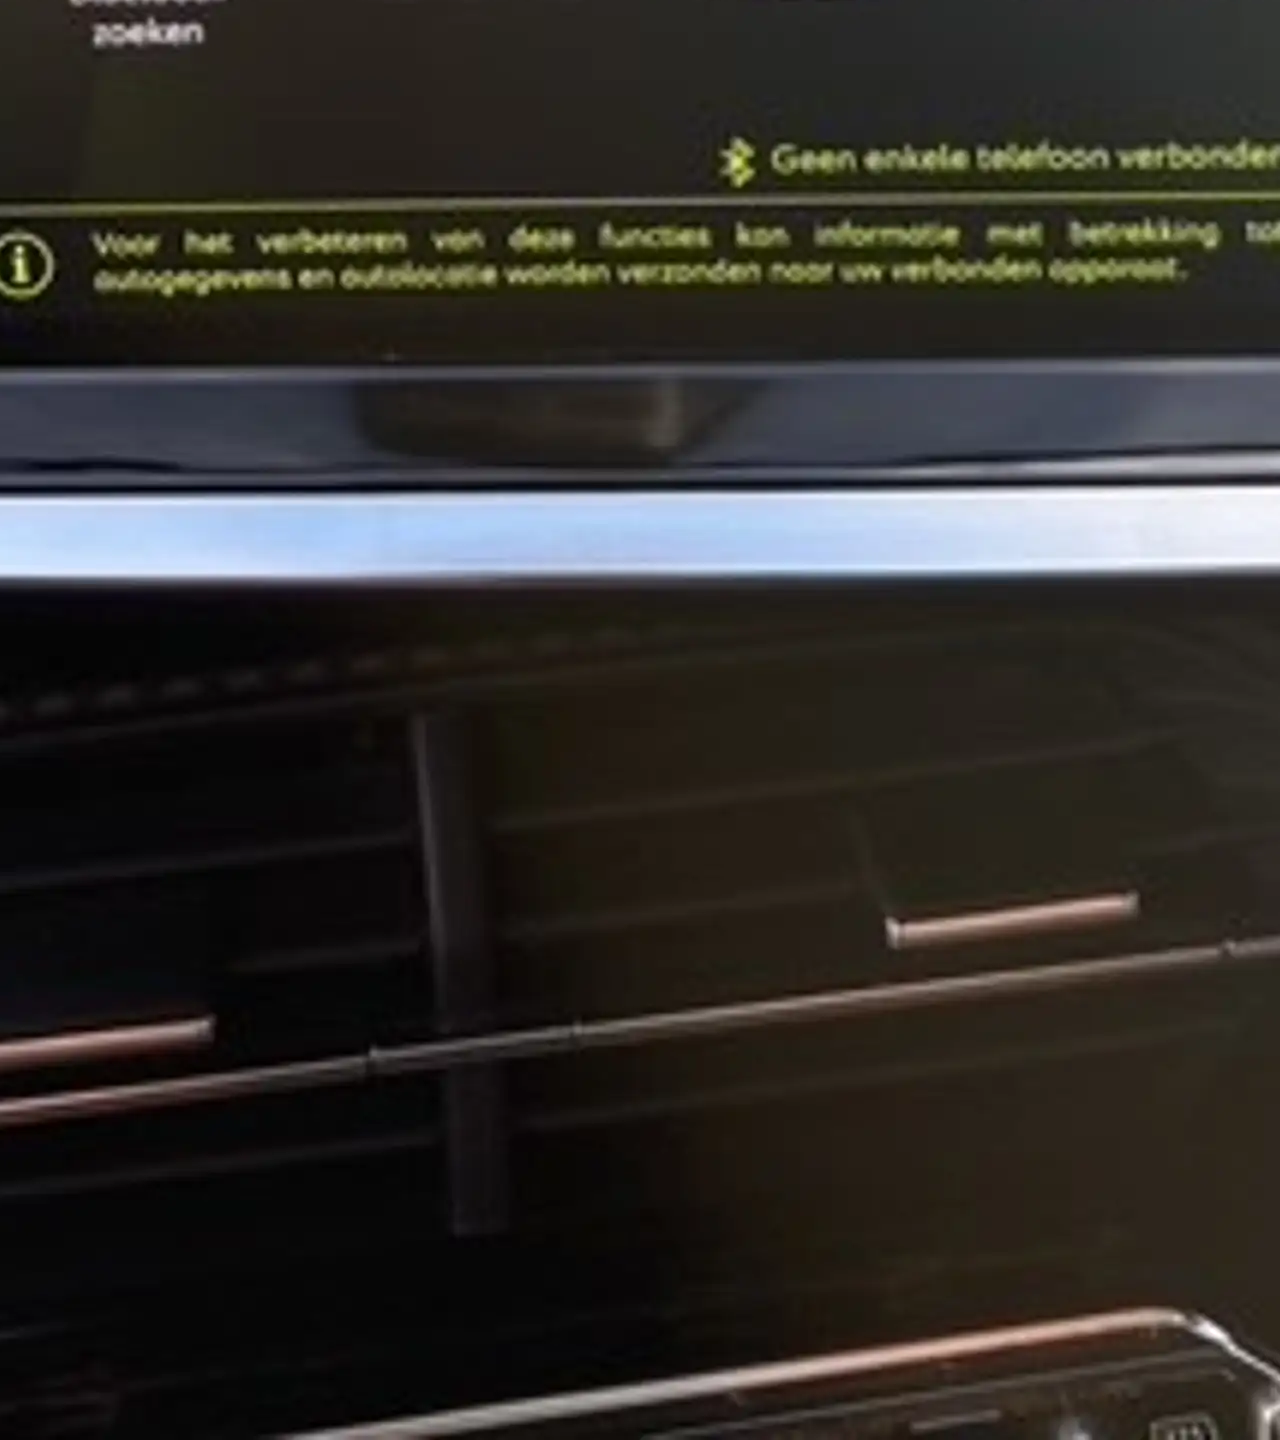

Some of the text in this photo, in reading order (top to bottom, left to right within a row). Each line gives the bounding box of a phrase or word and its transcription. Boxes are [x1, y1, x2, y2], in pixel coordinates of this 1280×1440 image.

[92, 17, 205, 48] zoeken
[771, 142, 857, 174] Geen
[863, 142, 970, 172] enkele
[976, 139, 1112, 171] telefoon
[813, 218, 962, 248] informatie
[986, 220, 1044, 247] met
[297, 267, 336, 291] en
[838, 261, 883, 283] uw
